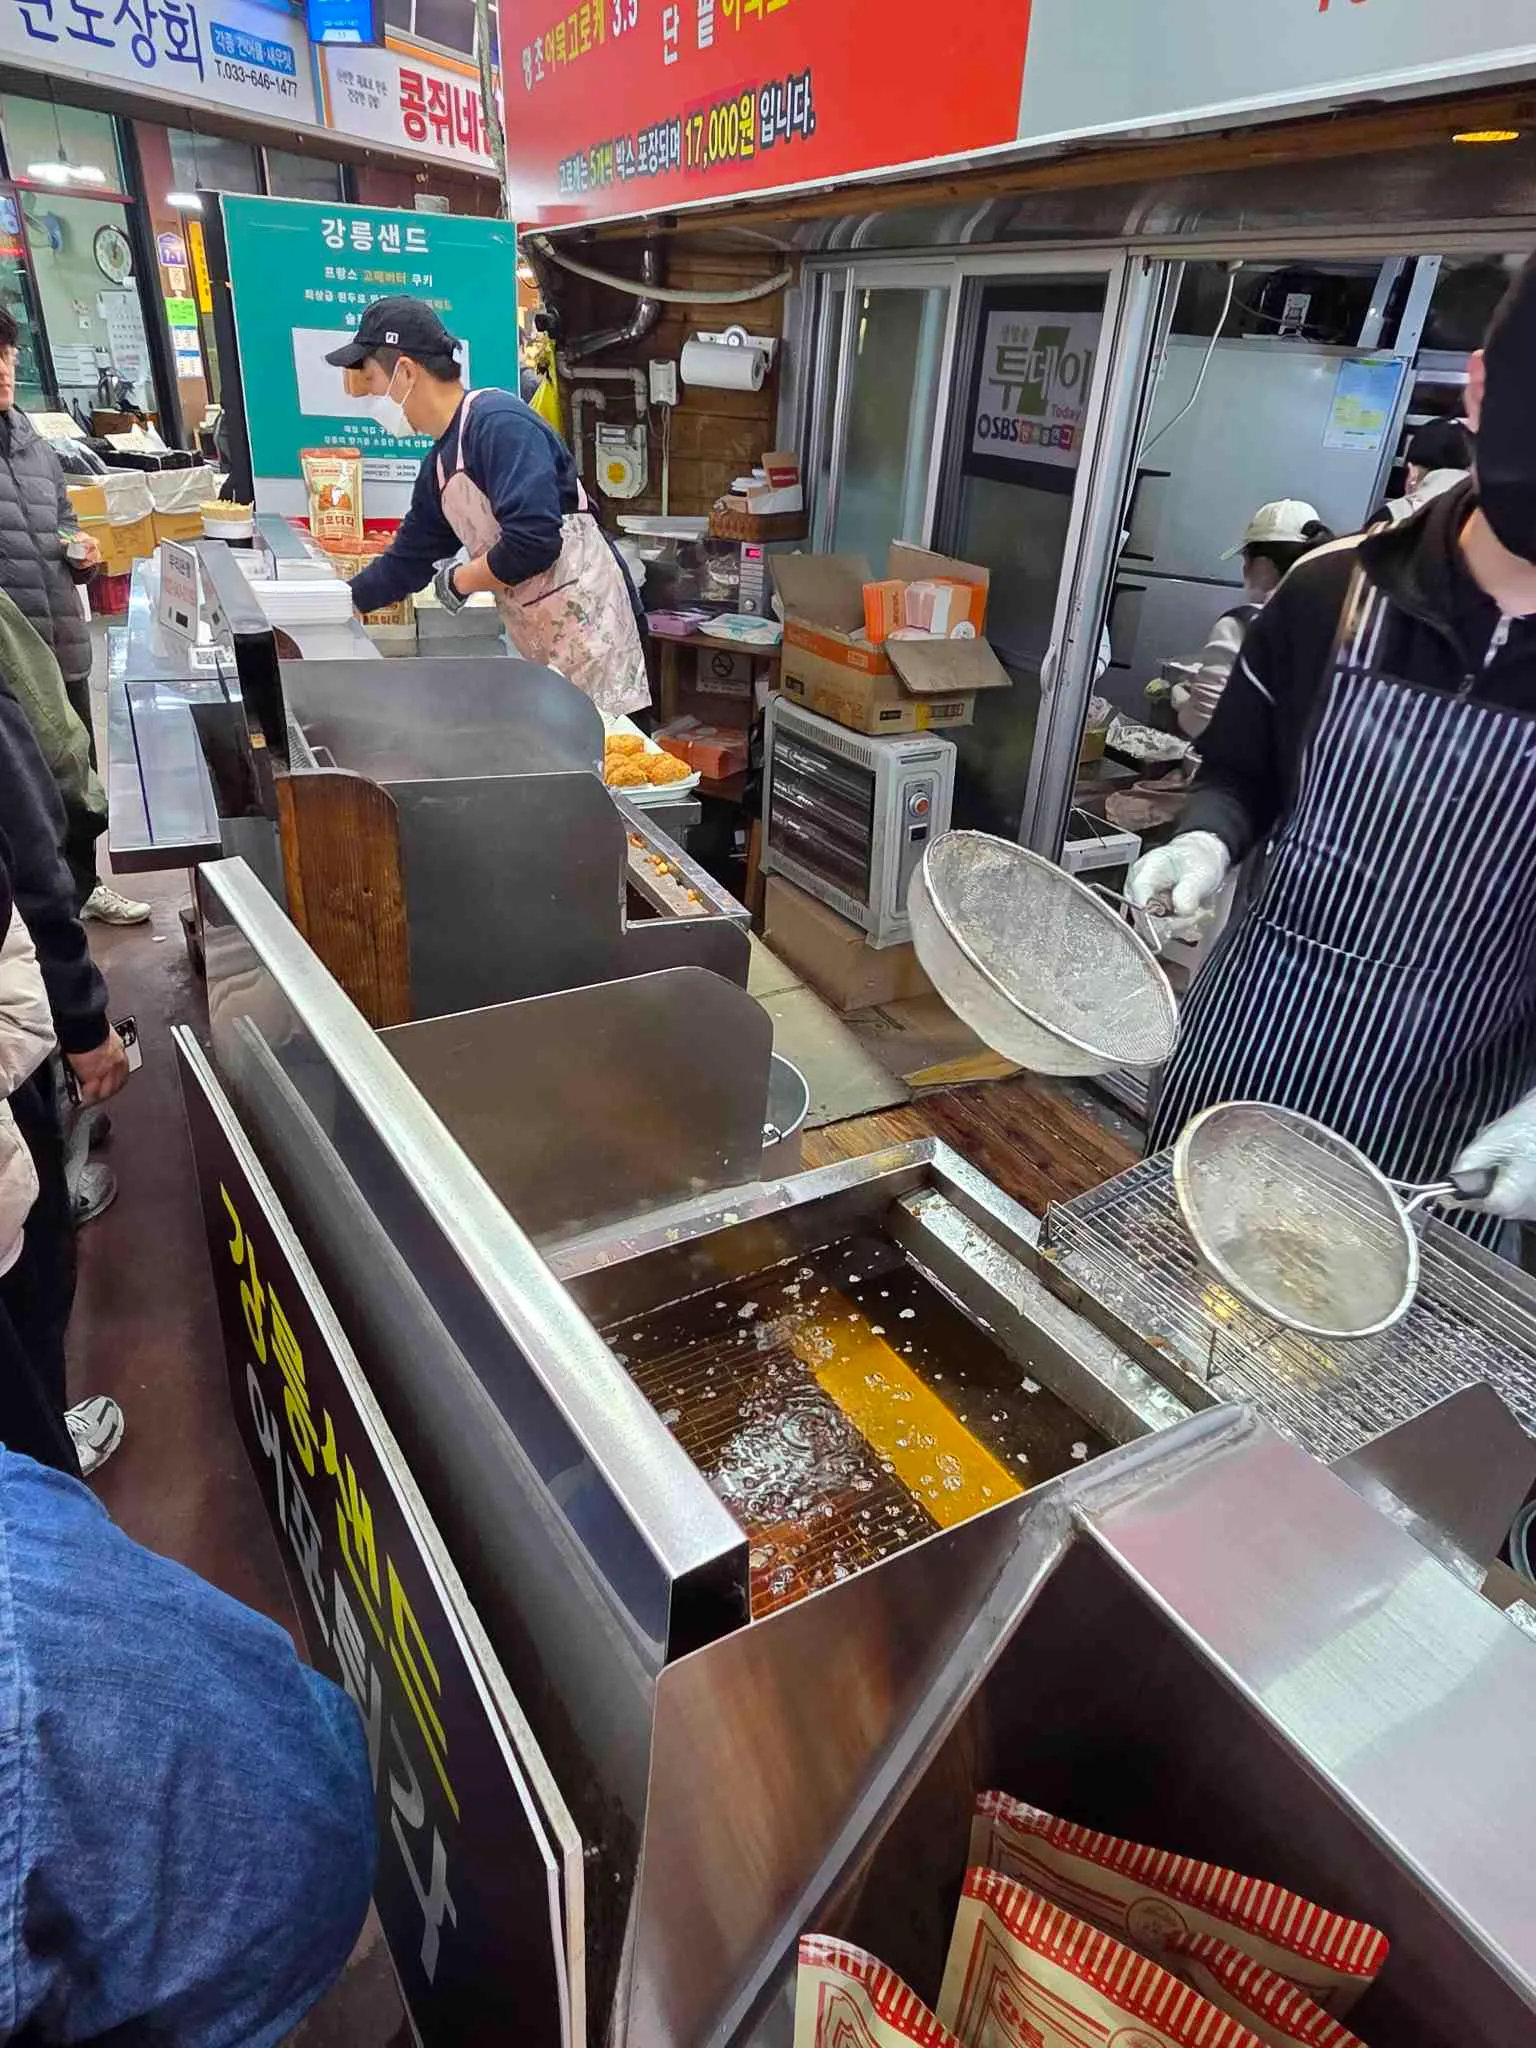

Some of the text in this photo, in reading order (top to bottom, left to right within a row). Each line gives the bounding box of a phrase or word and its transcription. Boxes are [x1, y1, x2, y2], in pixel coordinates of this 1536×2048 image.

[400, 67, 491, 155] 콩쥐네
[615, 139, 635, 180] 박스
[637, 118, 681, 173] 포장되며
[684, 92, 756, 169] 17,000원
[759, 73, 816, 143] 입니다.
[320, 218, 430, 253] 강릉샌드
[324, 266, 358, 281] 프랑스
[411, 272, 433, 288] 쿠키
[988, 345, 1093, 412] 투데이
[219, 1181, 461, 1823] 강릉샌드
